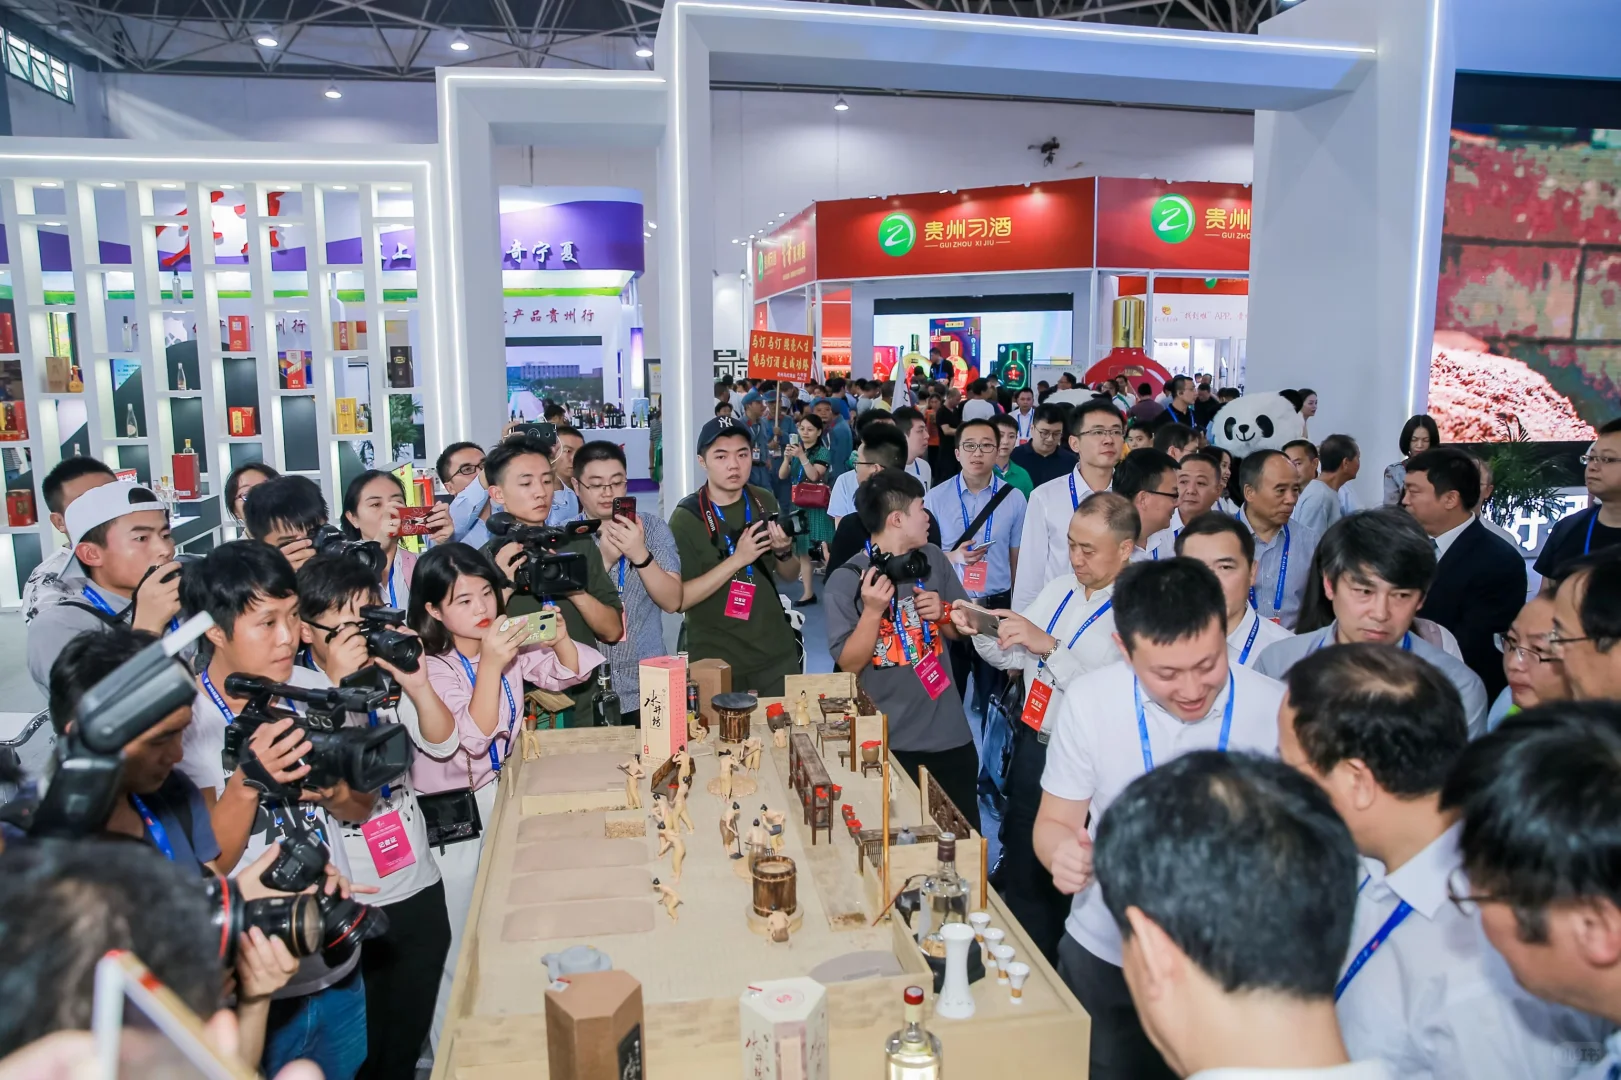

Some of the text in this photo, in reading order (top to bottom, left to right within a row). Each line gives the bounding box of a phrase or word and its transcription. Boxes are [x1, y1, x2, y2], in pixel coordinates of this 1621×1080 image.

[1205, 207, 1251, 230] 贵州
[924, 216, 1012, 241] 贵州习酒
[1221, 231, 1235, 239] GUI
[939, 241, 952, 249] GUI
[983, 239, 995, 247] JIU
[718, 416, 734, 428] NY
[643, 689, 662, 728] 水井坊
